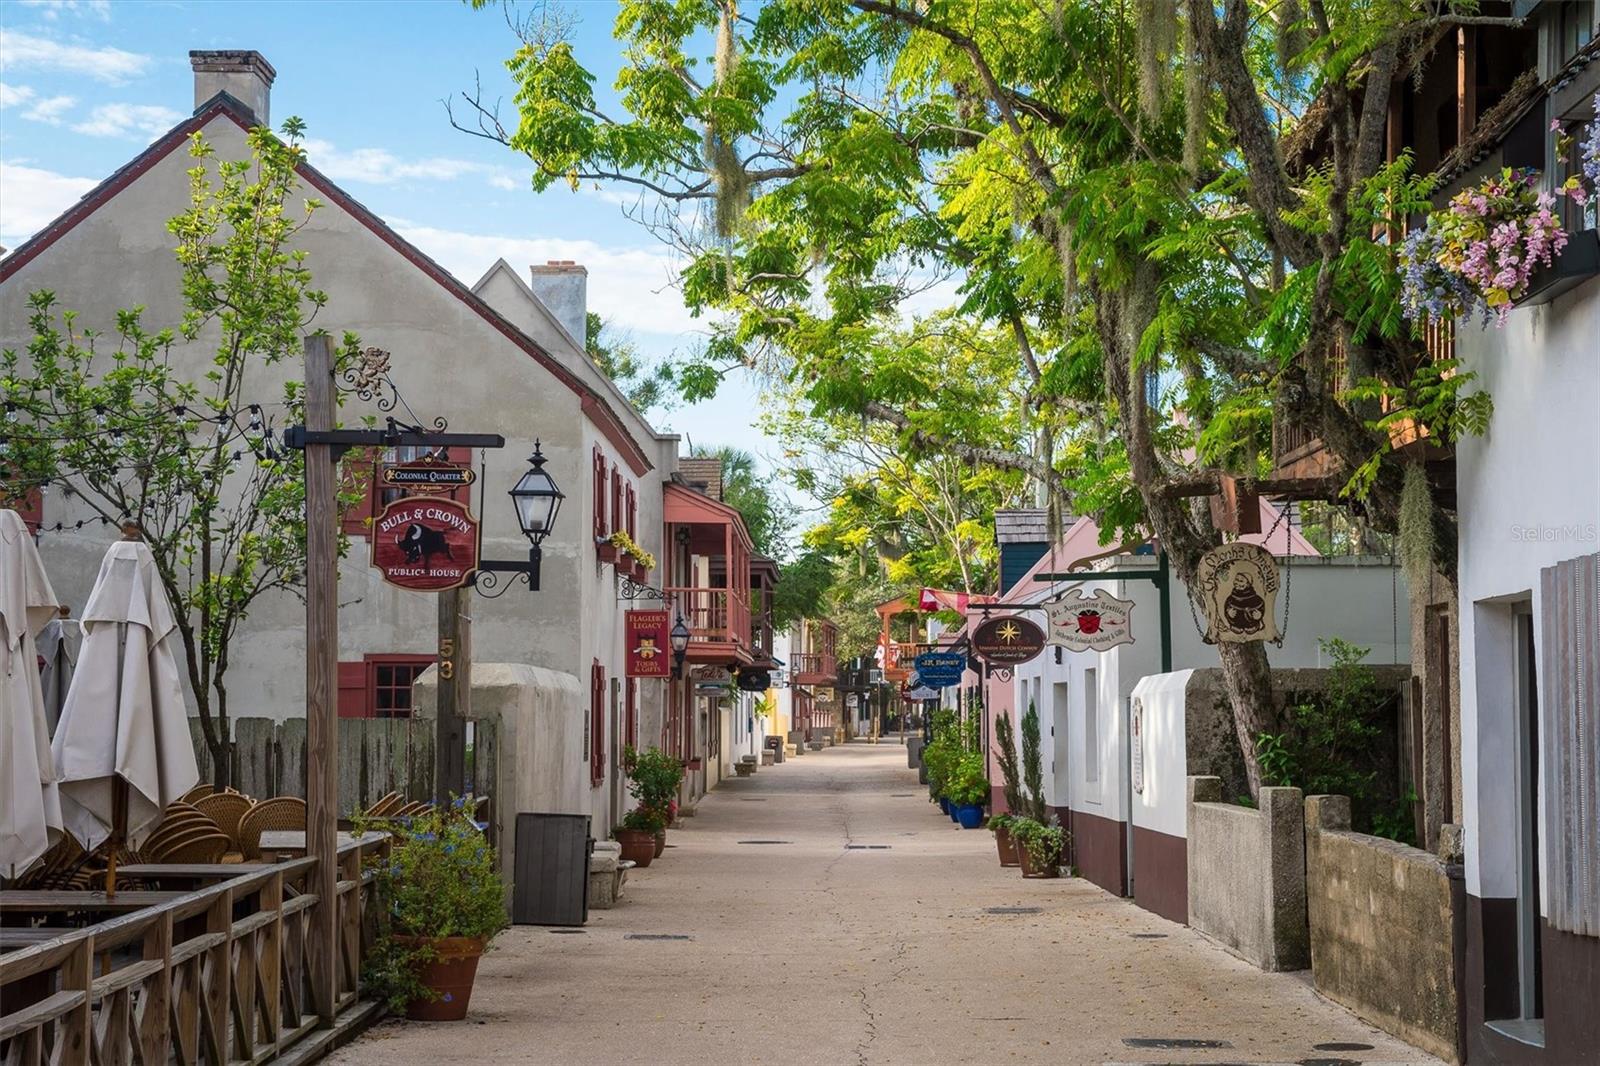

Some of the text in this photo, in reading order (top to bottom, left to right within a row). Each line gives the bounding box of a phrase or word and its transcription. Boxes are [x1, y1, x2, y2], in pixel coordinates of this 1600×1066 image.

[395, 471, 461, 482] COLONIAL QUARTER
[380, 508, 472, 534] BULL & CROWN
[429, 569, 461, 577] HOUSE
[1063, 600, 1100, 613] Augustine
[1100, 601, 1127, 617] Textiles
[633, 622, 662, 630] LEGACY
[440, 639, 453, 679] 53
